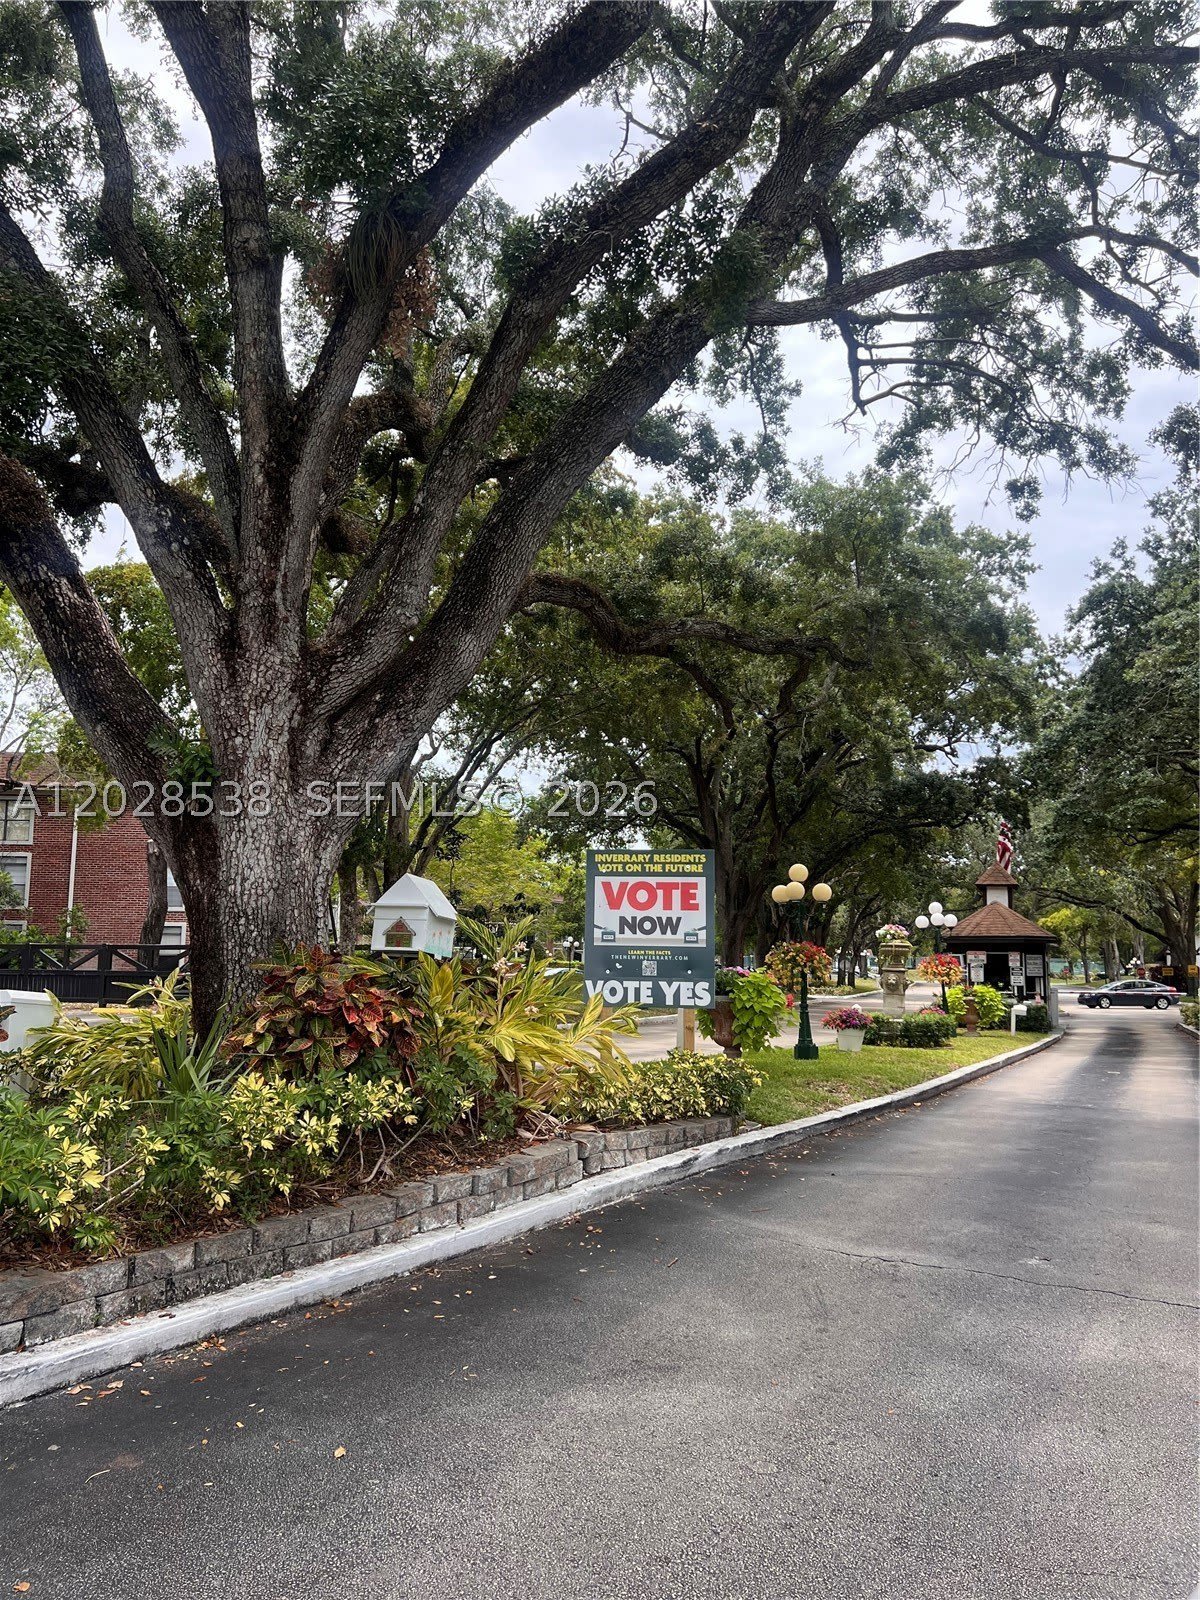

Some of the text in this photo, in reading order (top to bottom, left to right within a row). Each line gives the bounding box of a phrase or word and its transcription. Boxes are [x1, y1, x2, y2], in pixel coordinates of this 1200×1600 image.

[595, 854, 706, 863] INVERRARY RESIDENTS
[597, 864, 703, 872] VOTE ON THE FUTURE
[601, 881, 699, 911] VOTE
[619, 916, 682, 935] NOW
[585, 980, 711, 1007] VOTE YES
